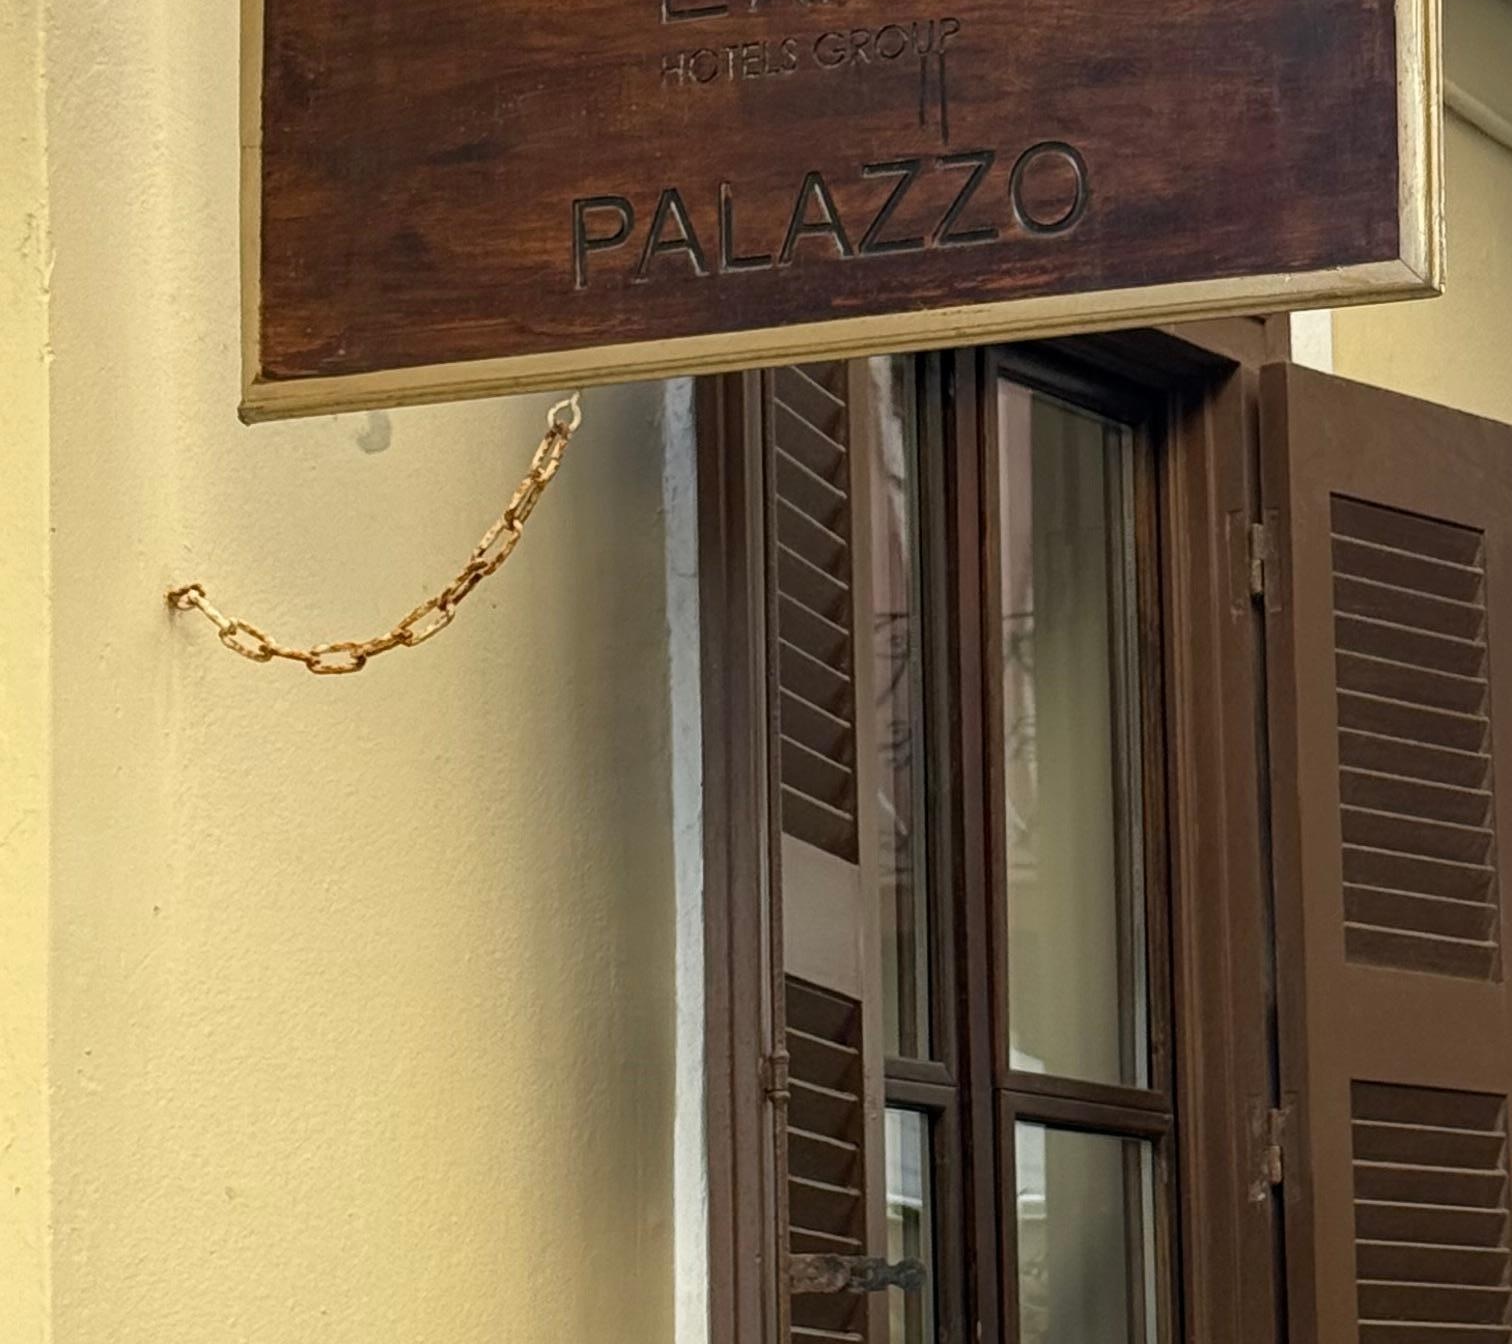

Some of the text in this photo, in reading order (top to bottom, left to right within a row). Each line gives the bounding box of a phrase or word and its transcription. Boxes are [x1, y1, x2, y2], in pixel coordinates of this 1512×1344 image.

[660, 16, 962, 89] HOTELS GROUP
[572, 140, 1089, 290] PALAZZO
